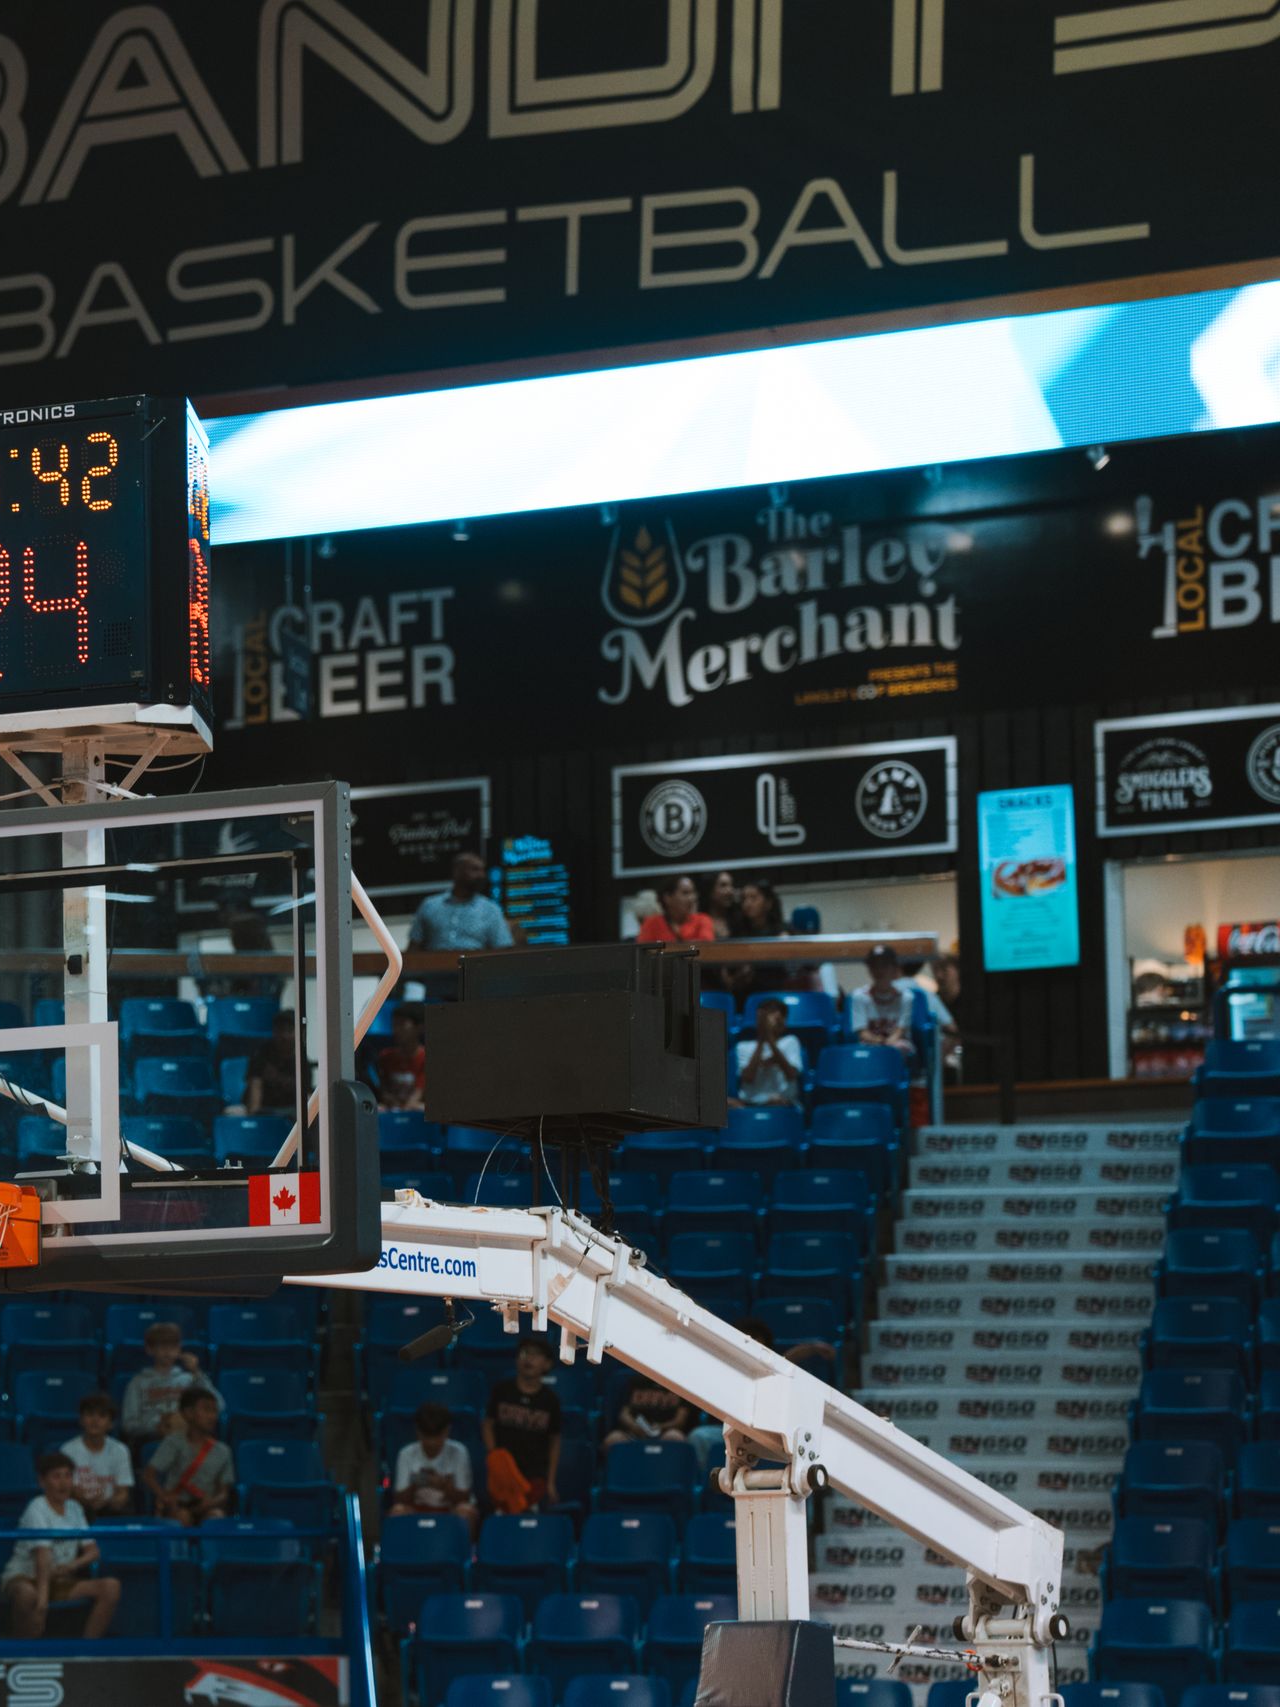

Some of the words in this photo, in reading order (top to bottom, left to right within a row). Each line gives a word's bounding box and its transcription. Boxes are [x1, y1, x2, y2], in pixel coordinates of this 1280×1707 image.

[685, 523, 948, 614] Barley
[756, 505, 832, 542] The
[1175, 504, 1207, 633] LOCAL
[598, 593, 963, 709] Merchant
[375, 1247, 477, 1278] sCentre.com
